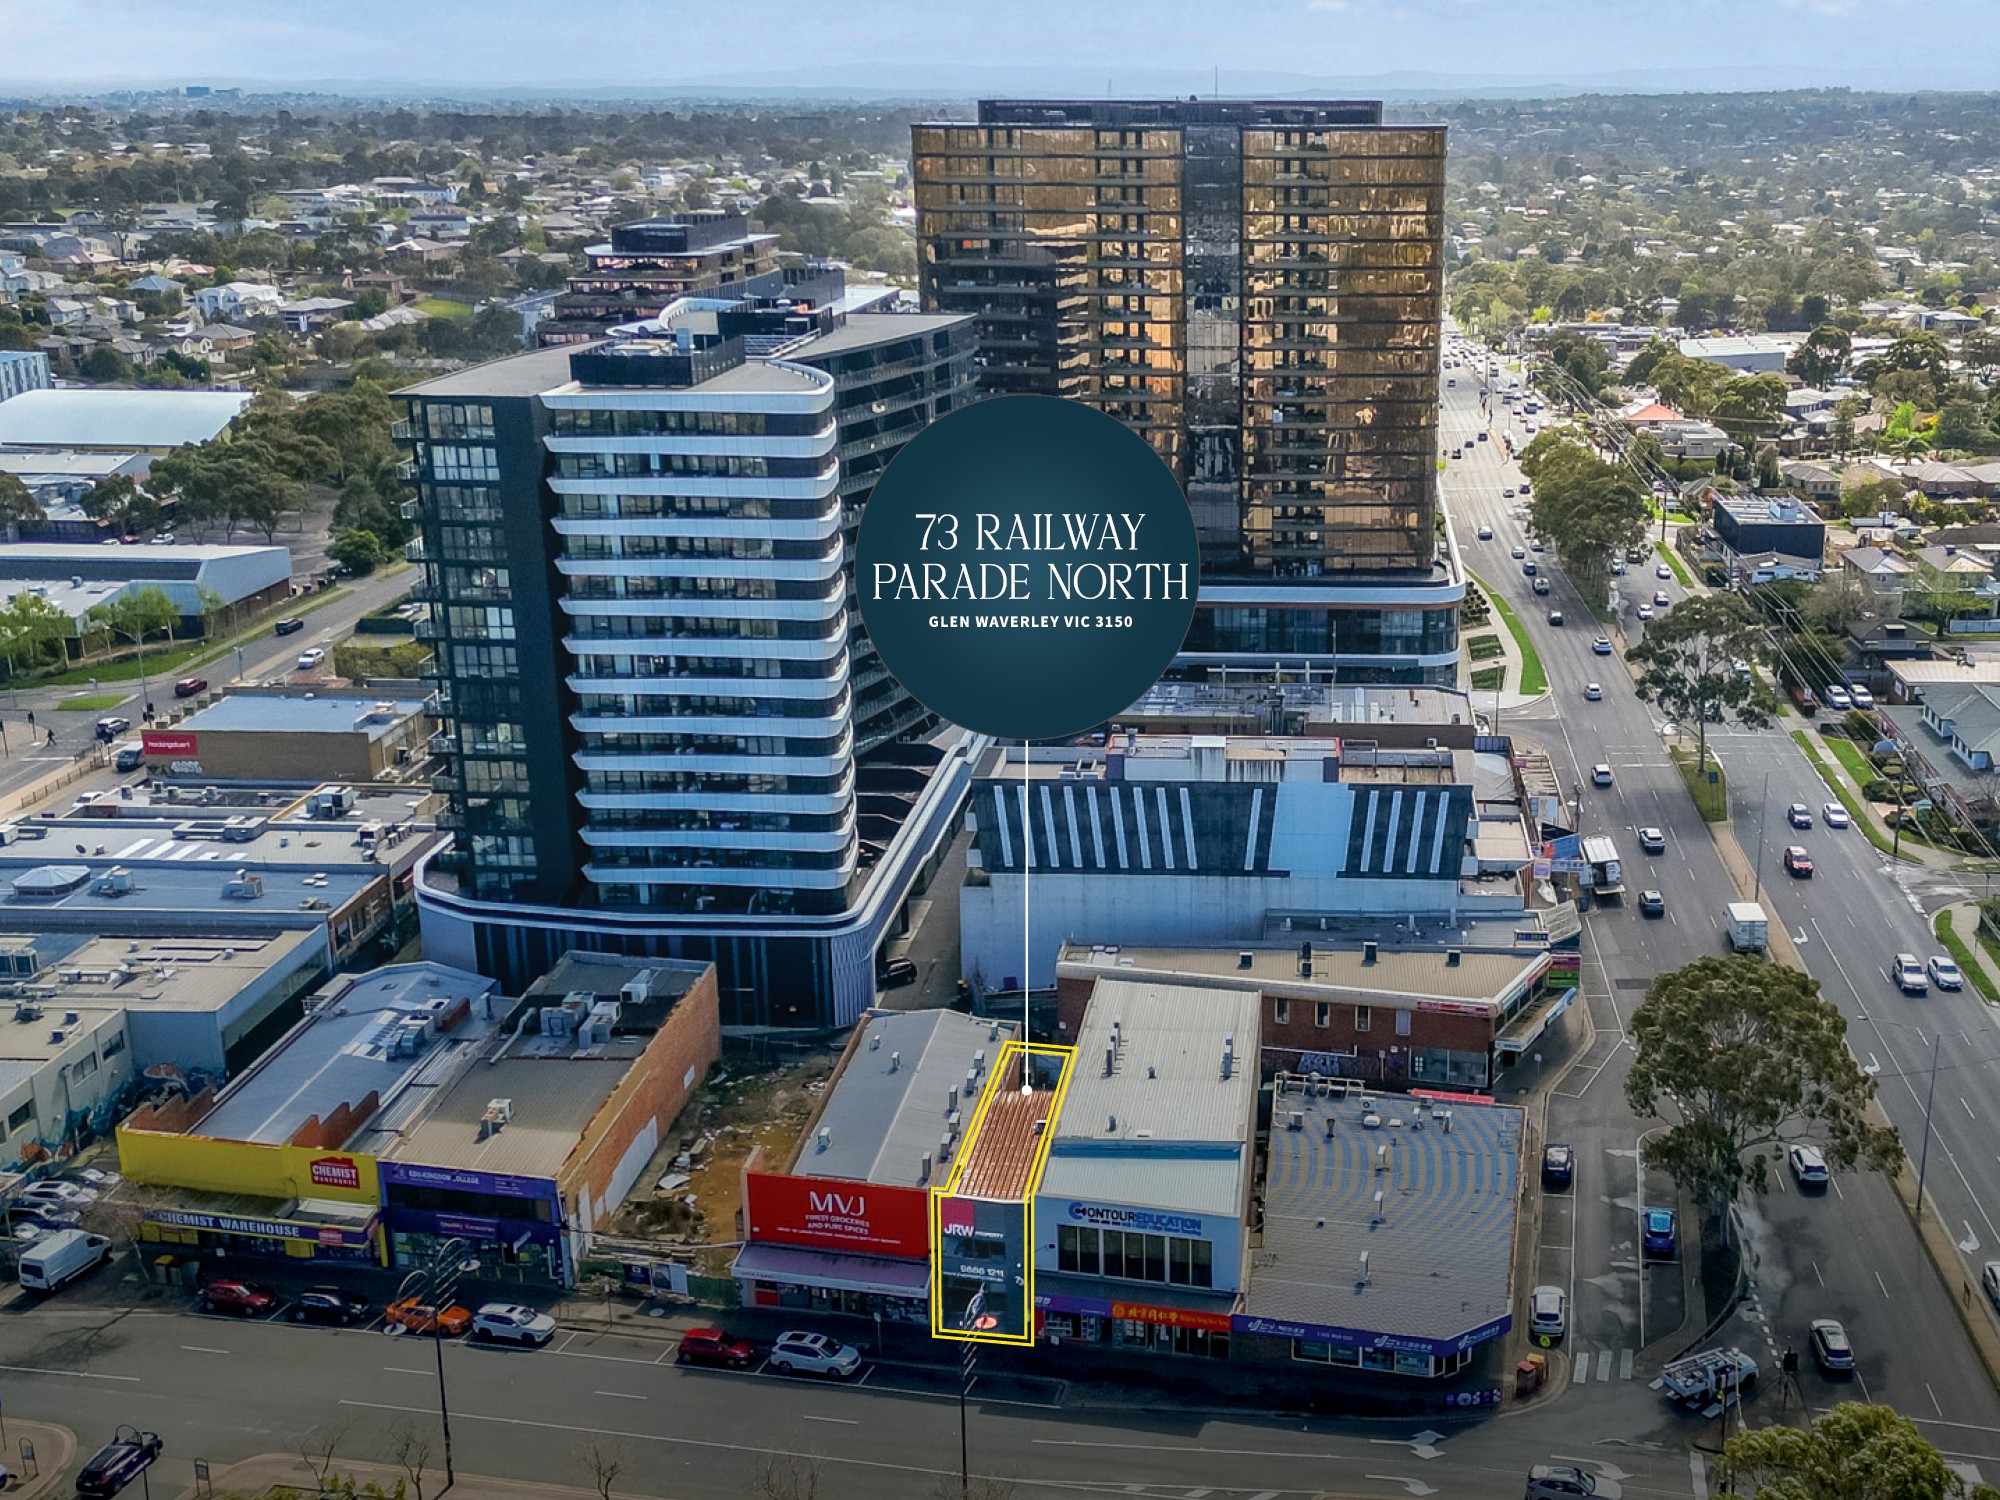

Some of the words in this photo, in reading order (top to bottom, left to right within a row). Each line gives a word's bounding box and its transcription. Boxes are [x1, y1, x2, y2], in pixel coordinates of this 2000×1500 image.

[312, 1165, 357, 1180] CHEMIST
[313, 1176, 357, 1187] WAREHOUSE
[809, 1190, 865, 1217] MVJ
[159, 1212, 214, 1228] CHEMIST
[218, 1218, 301, 1237] WAREHOUSE
[944, 1223, 975, 1237] JRW
